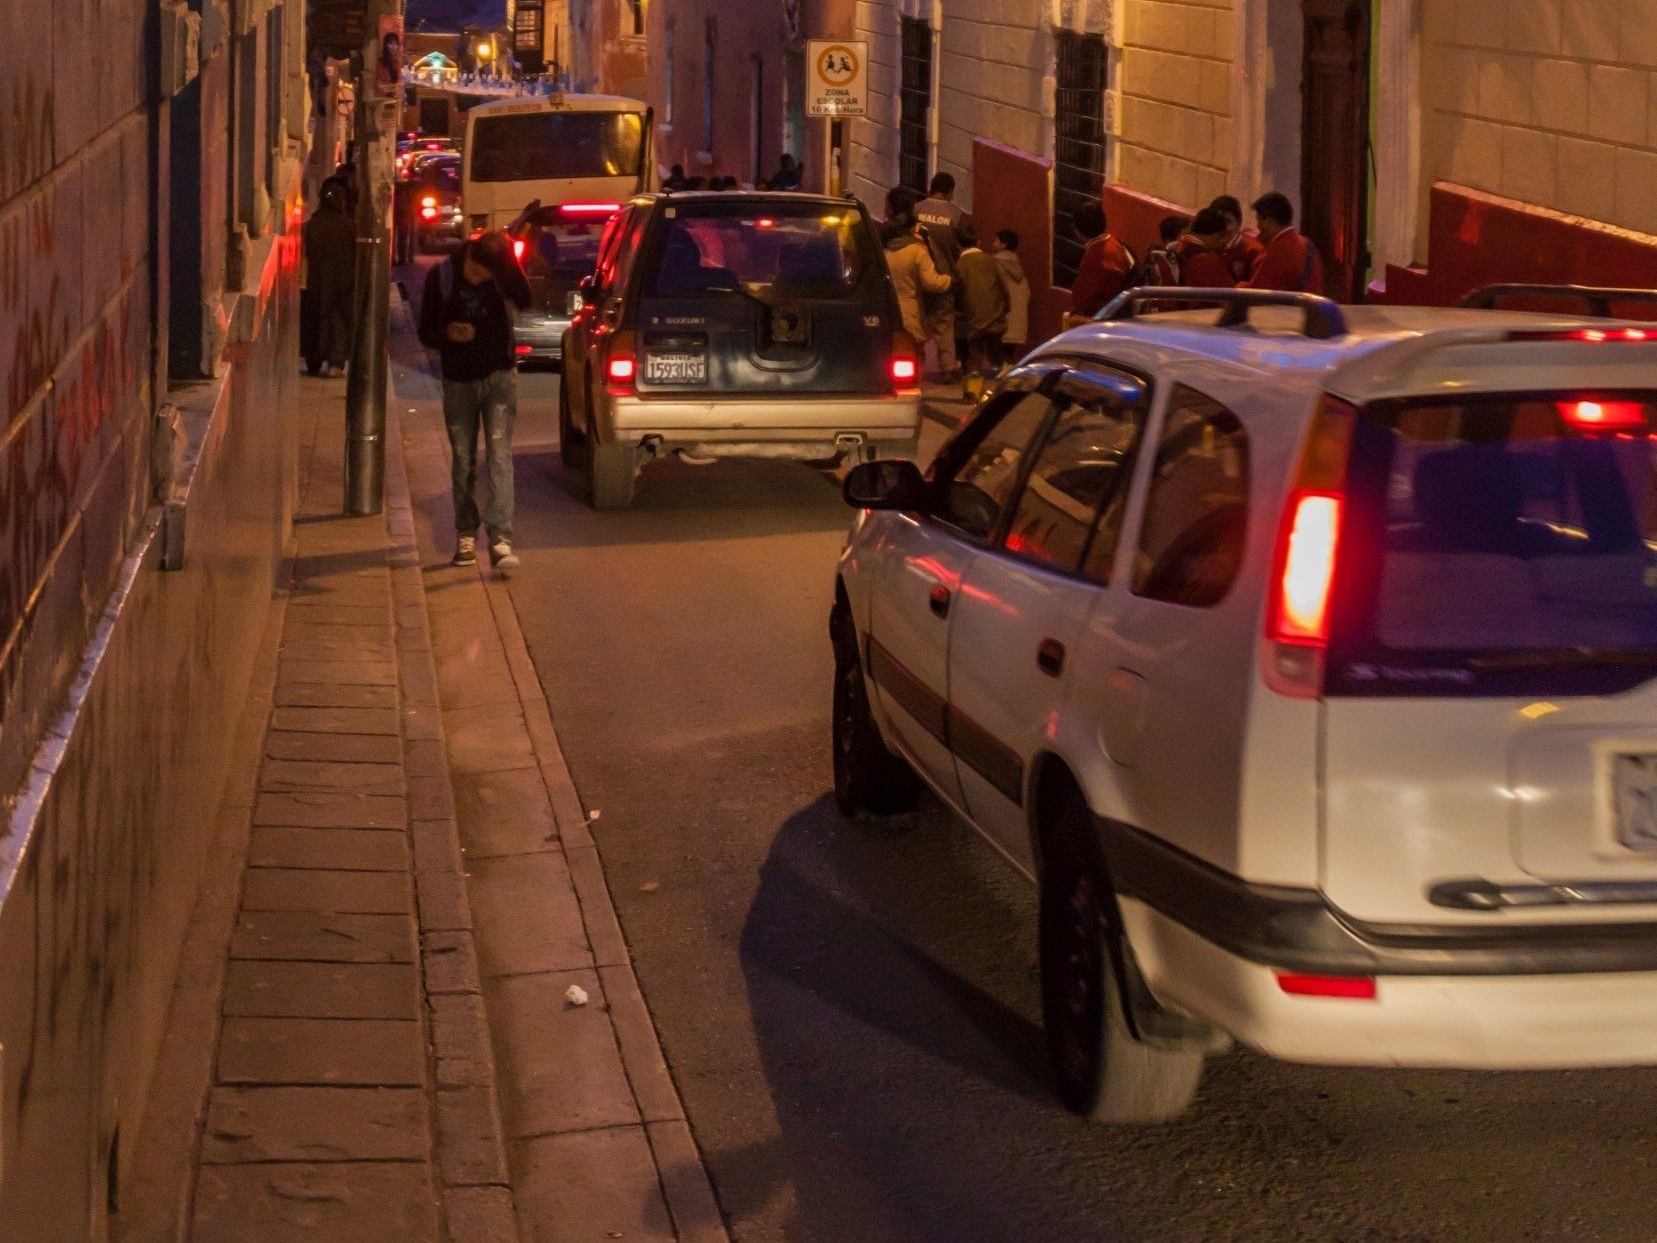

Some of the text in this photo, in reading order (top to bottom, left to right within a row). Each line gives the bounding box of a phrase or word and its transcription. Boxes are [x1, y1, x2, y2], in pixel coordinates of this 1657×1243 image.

[825, 88, 849, 96] ZONA
[817, 97, 858, 105] ESCOLAR
[918, 213, 951, 225] WALON
